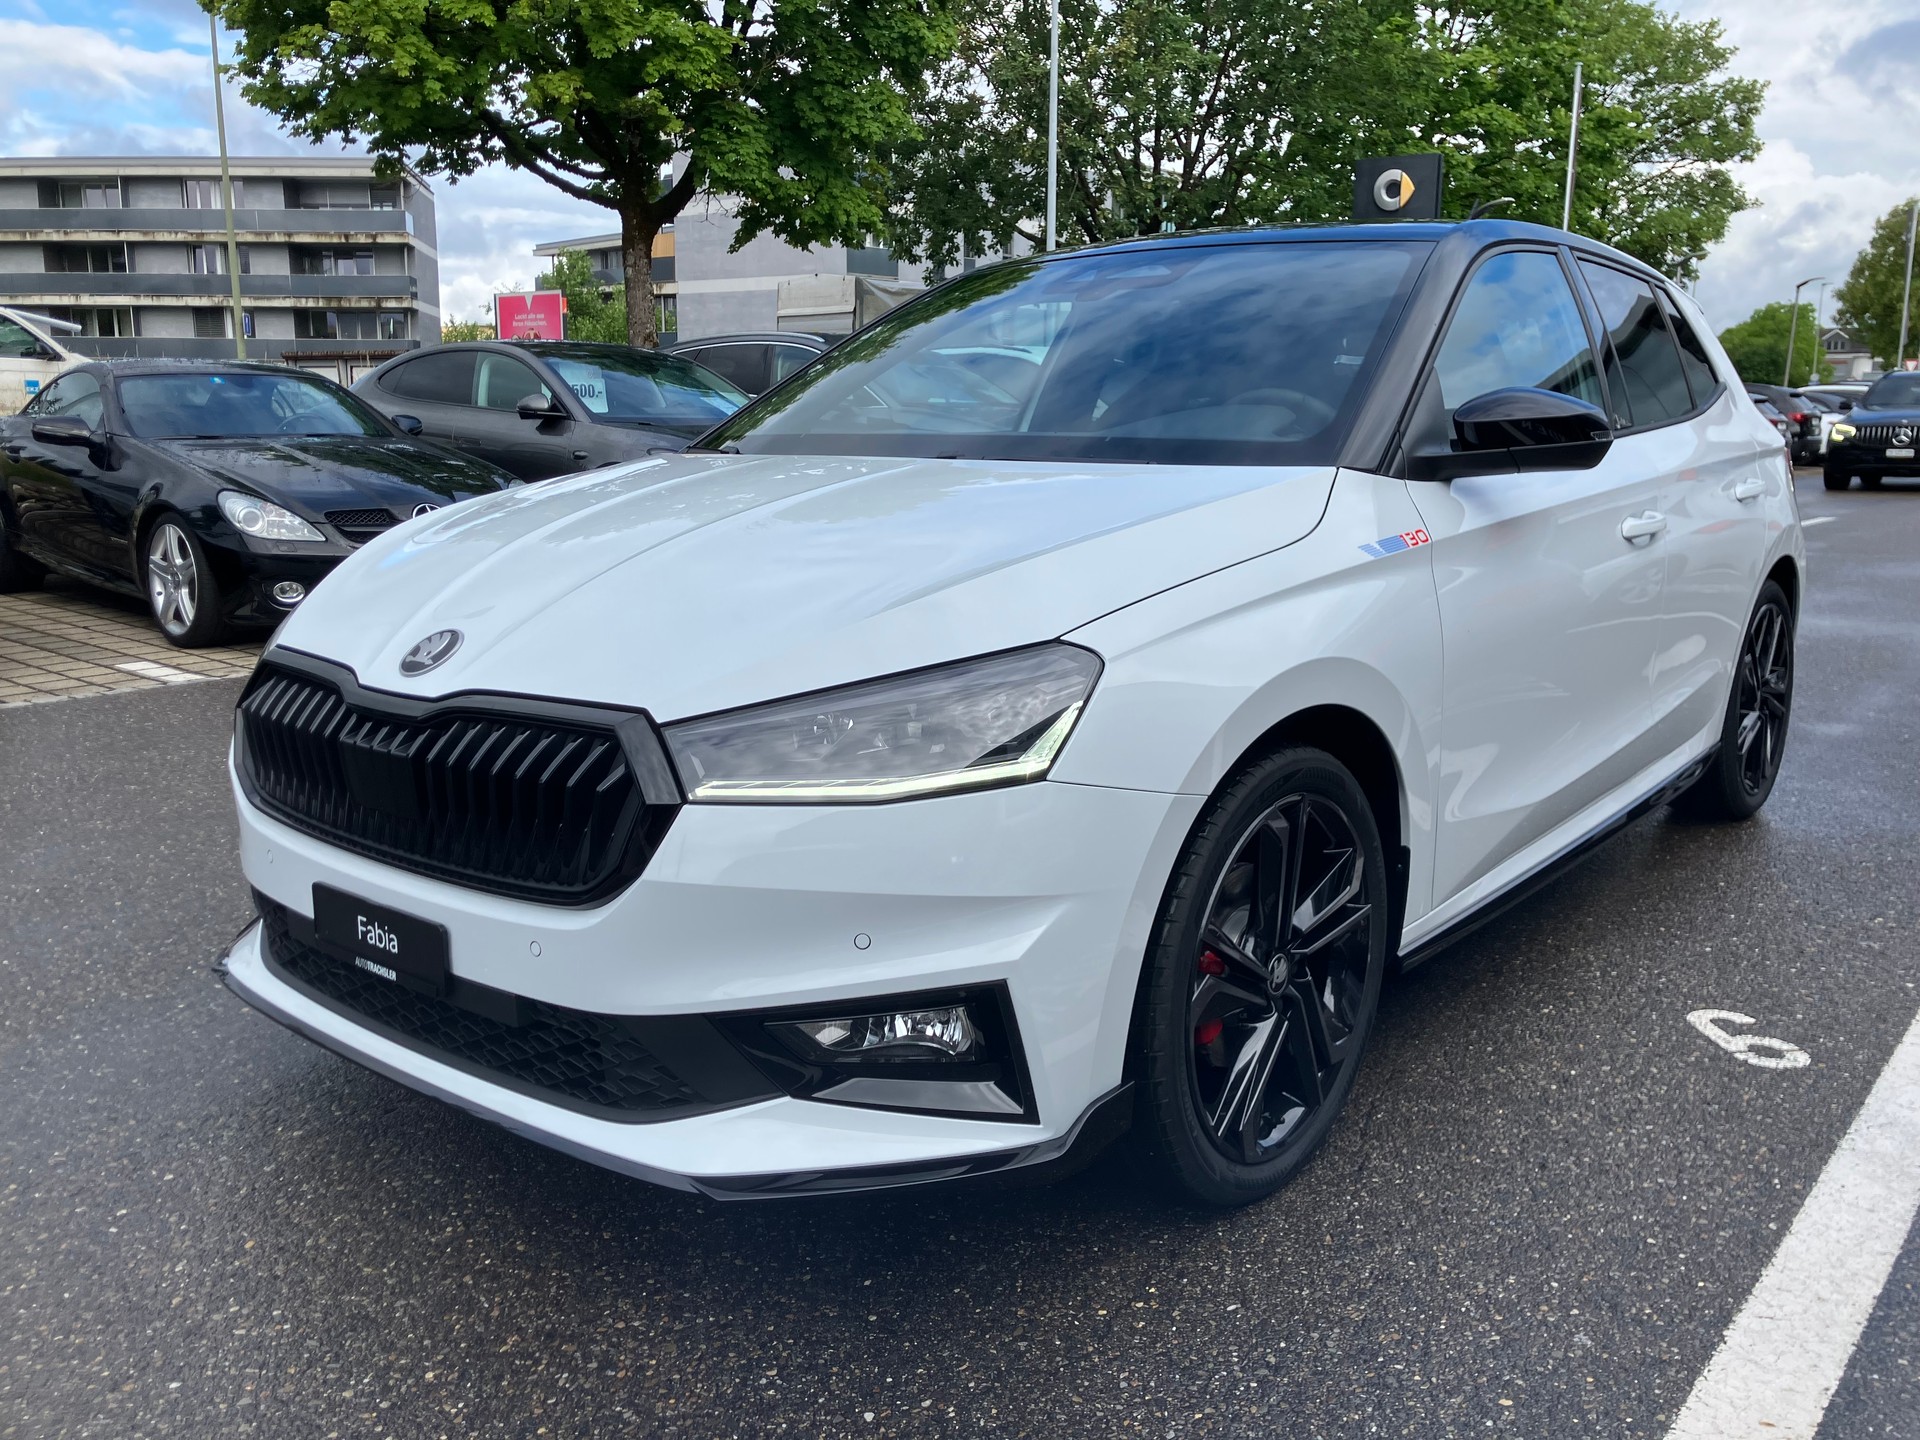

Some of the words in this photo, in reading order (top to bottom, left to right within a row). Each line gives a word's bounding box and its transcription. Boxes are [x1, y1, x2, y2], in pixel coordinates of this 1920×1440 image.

[1398, 528, 1429, 549] 130
[357, 914, 398, 954] Fabia
[1686, 1008, 1812, 1070] 6
